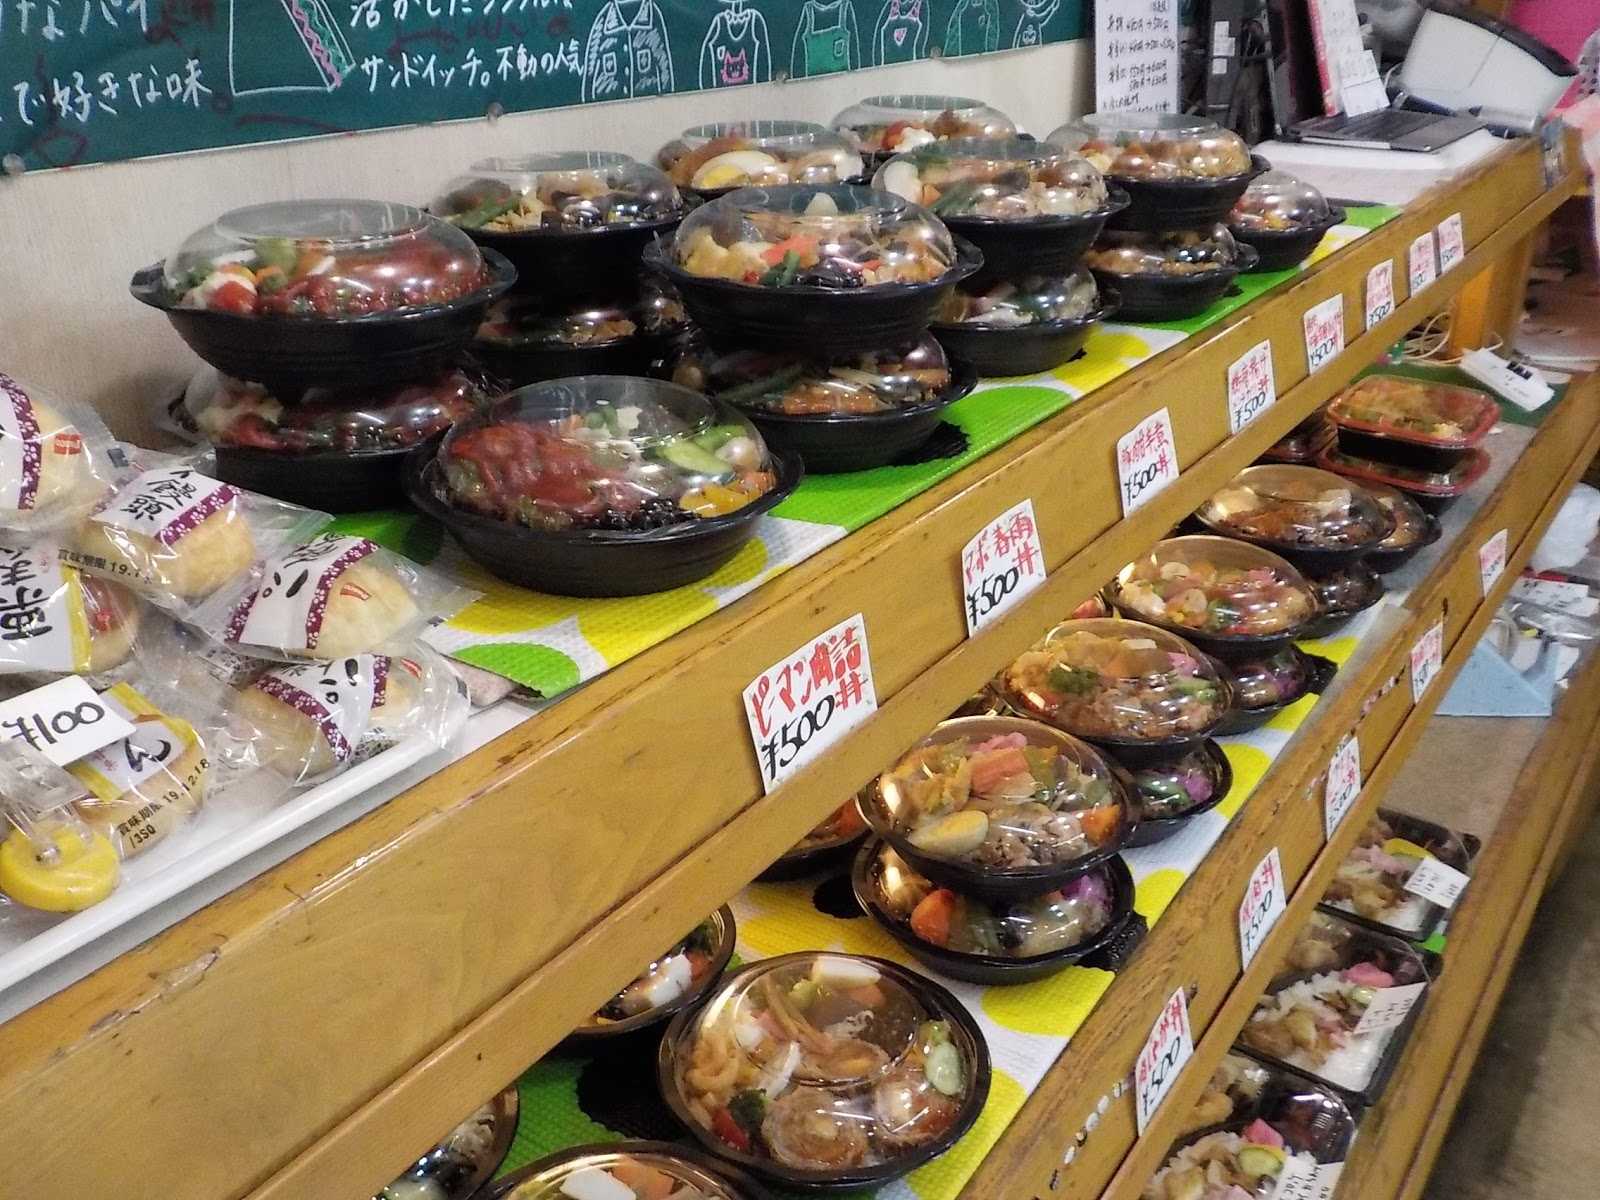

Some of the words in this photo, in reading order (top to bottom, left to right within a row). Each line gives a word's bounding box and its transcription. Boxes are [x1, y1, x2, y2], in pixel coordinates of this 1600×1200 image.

[13, 58, 212, 125] で好きな味
[1124, 463, 1158, 506] ¥500
[966, 566, 1020, 626] ¥500
[2, 702, 105, 752] ¥100
[761, 694, 835, 780] ¥500
[1142, 1035, 1181, 1116] ¥500
